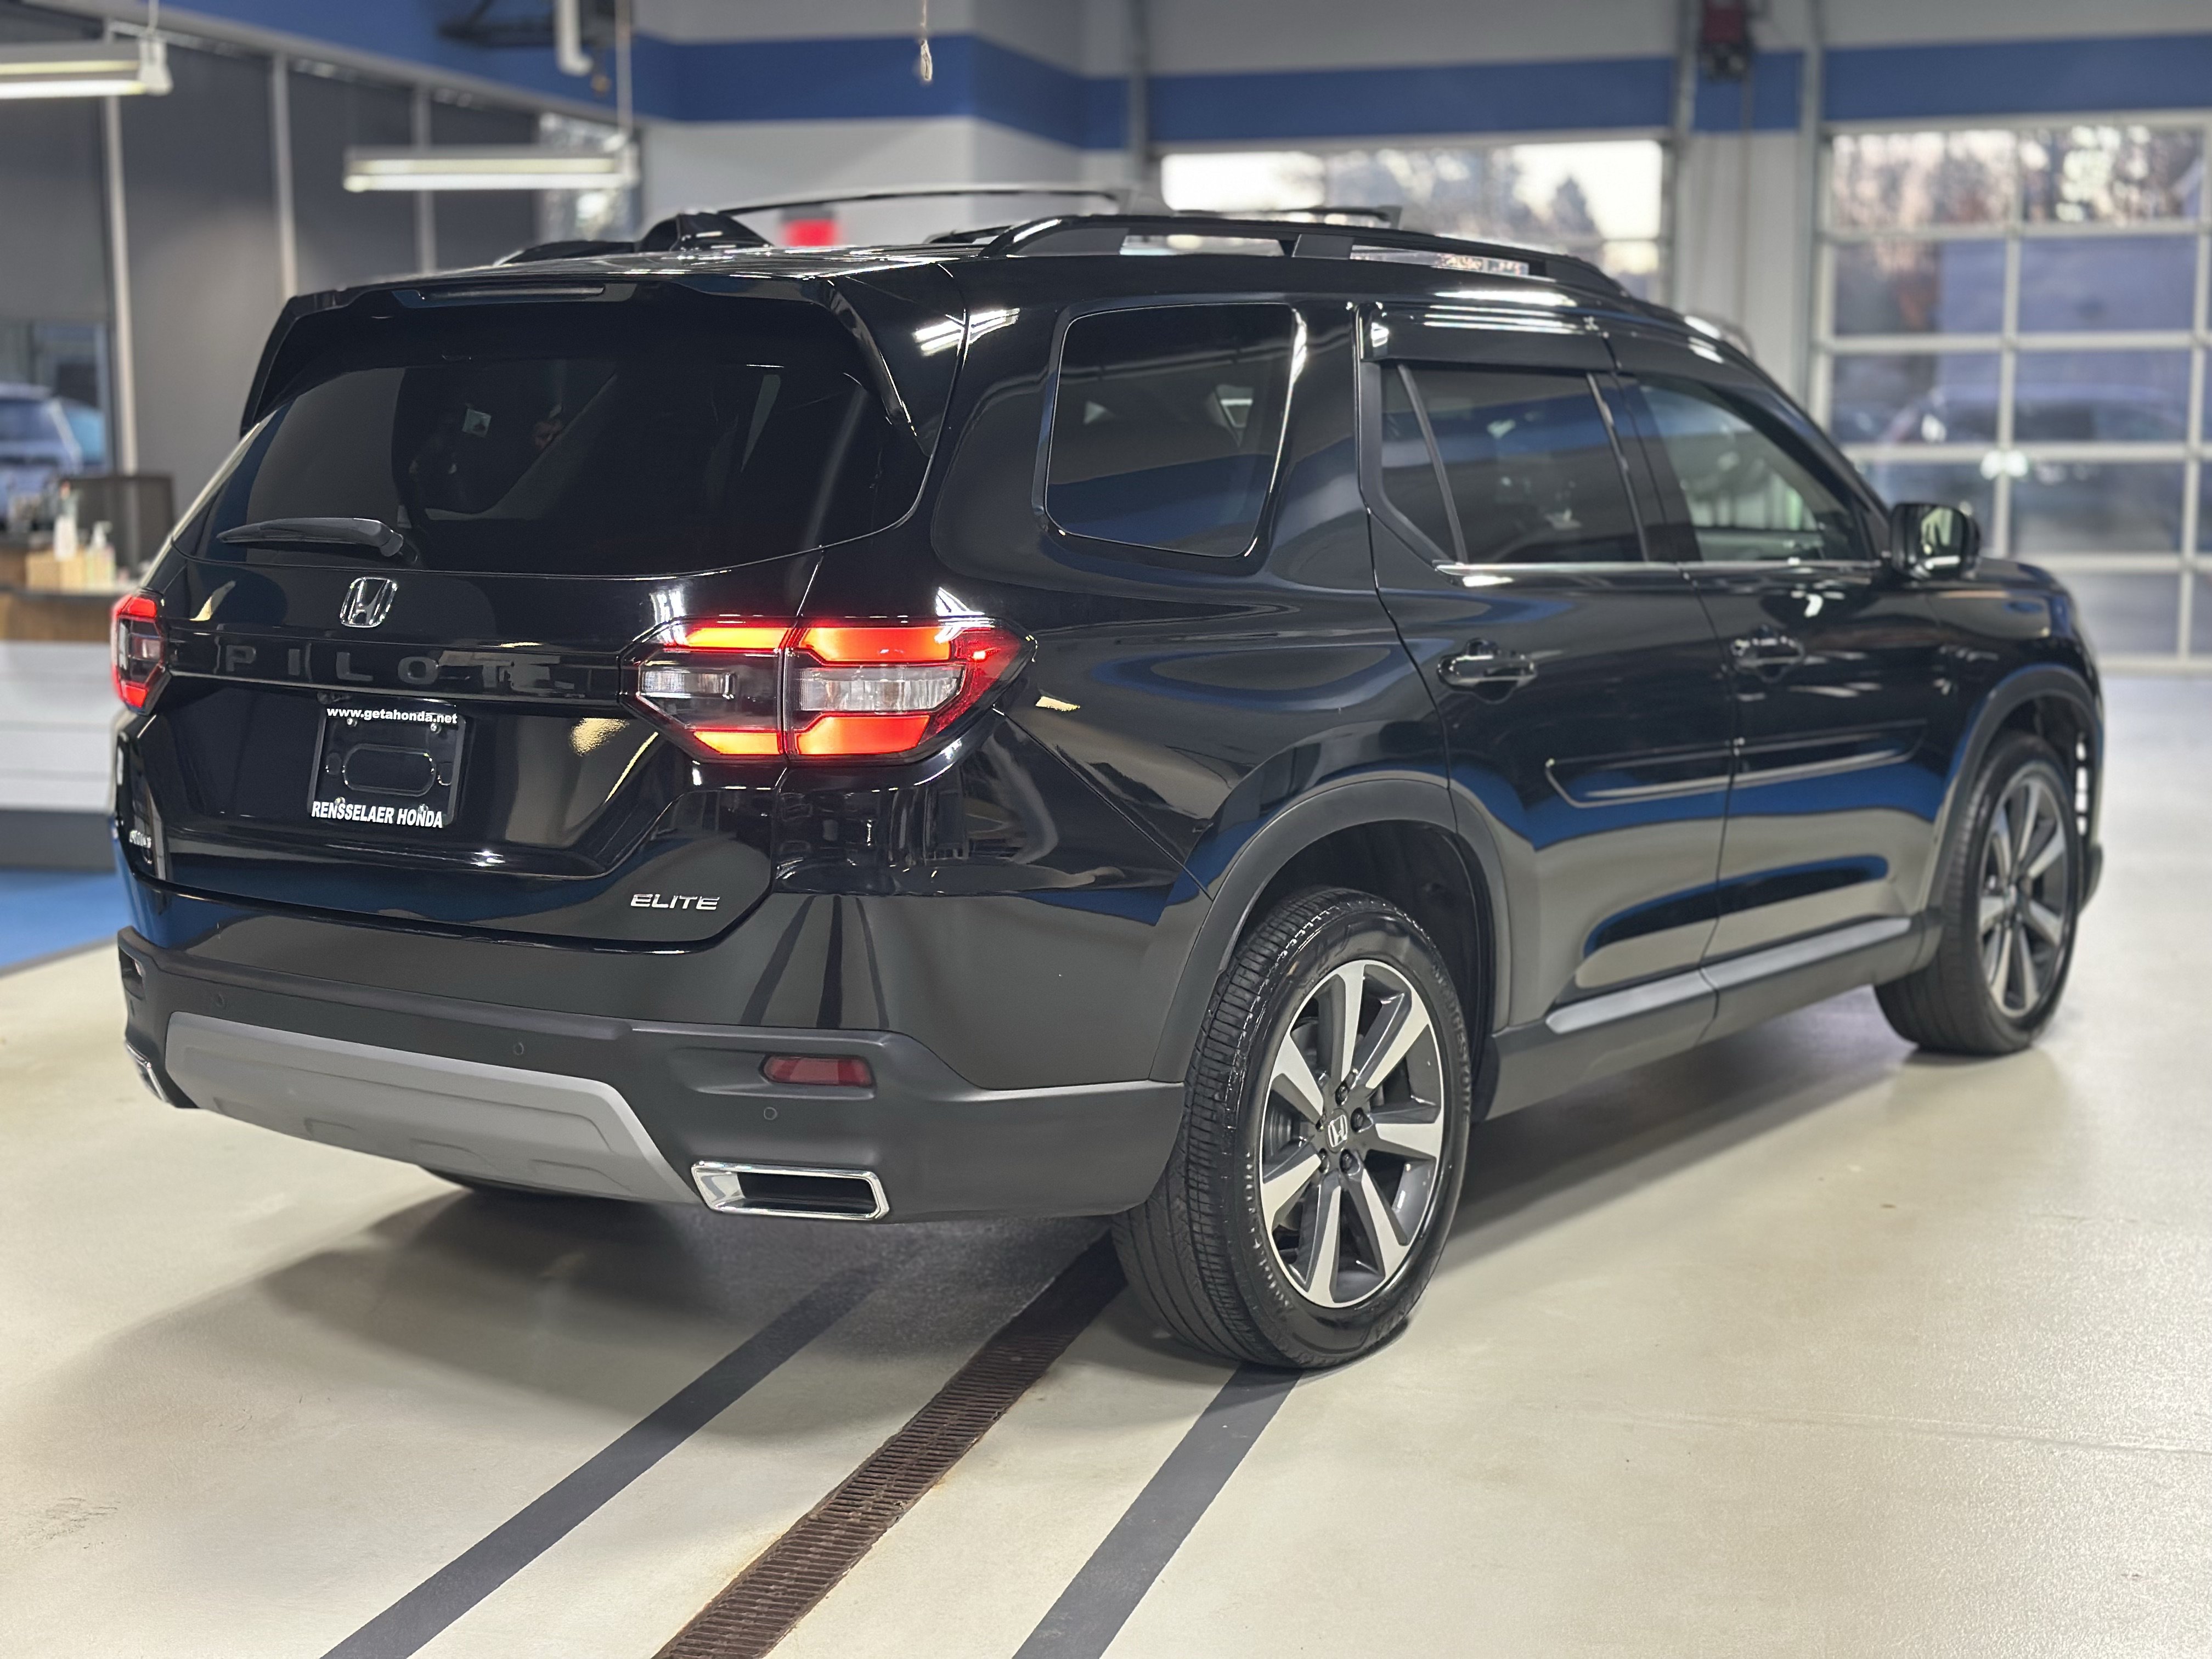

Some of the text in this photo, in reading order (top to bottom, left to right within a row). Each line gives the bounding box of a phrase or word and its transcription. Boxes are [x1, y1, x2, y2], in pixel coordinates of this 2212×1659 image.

[225, 644, 512, 689] PILOT
[326, 708, 458, 724] www.getahonda.net
[311, 800, 443, 828] RENSSELAER HONDA
[630, 894, 720, 910] ELITE
